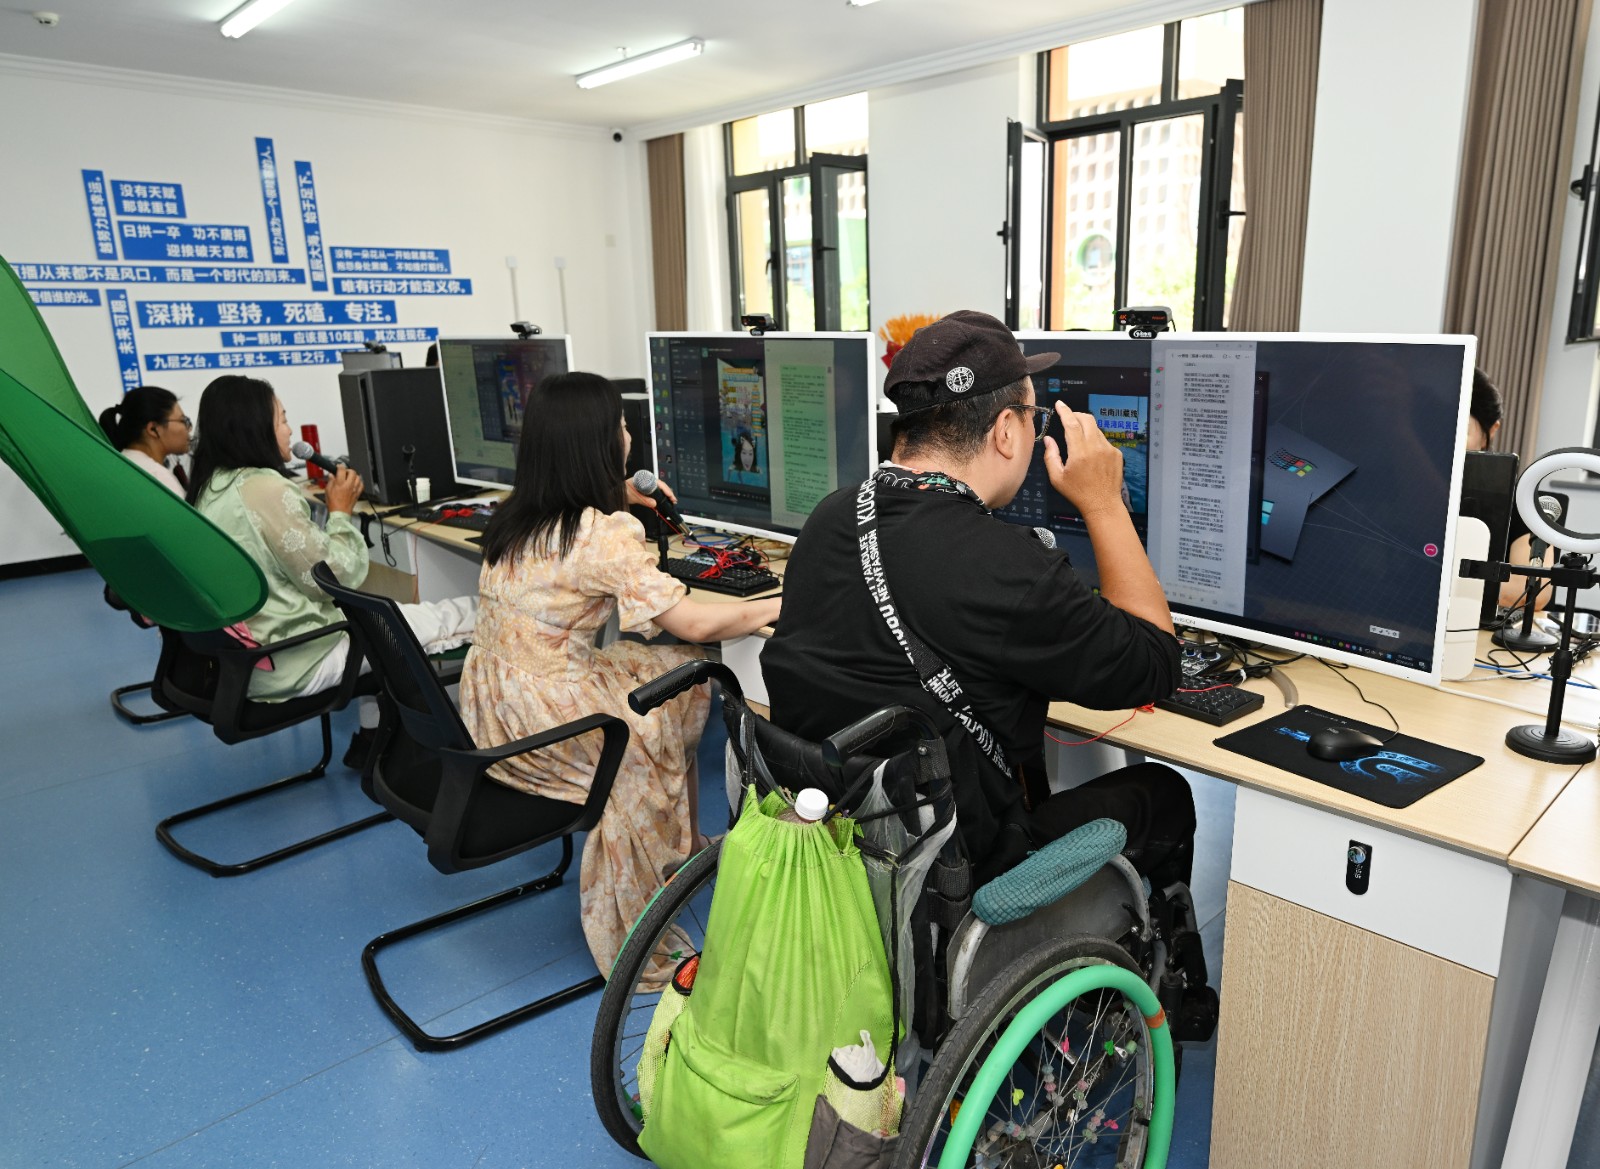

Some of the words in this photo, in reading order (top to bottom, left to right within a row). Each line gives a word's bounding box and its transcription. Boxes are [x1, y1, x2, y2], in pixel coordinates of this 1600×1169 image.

[120, 183, 177, 200] 没有天赋
[88, 177, 113, 254] 越努力越幸运。
[123, 200, 179, 215] 那就重复
[123, 224, 181, 239] 日拱一卒
[192, 227, 247, 242] 功不唐捐
[299, 171, 325, 282] 星辰大海，始于足下。
[341, 279, 466, 293] 唯有行动才能定义你。
[146, 302, 392, 325] 深耕，坚持，死磕，专注。
[868, 529, 891, 602] NEWFASHION
